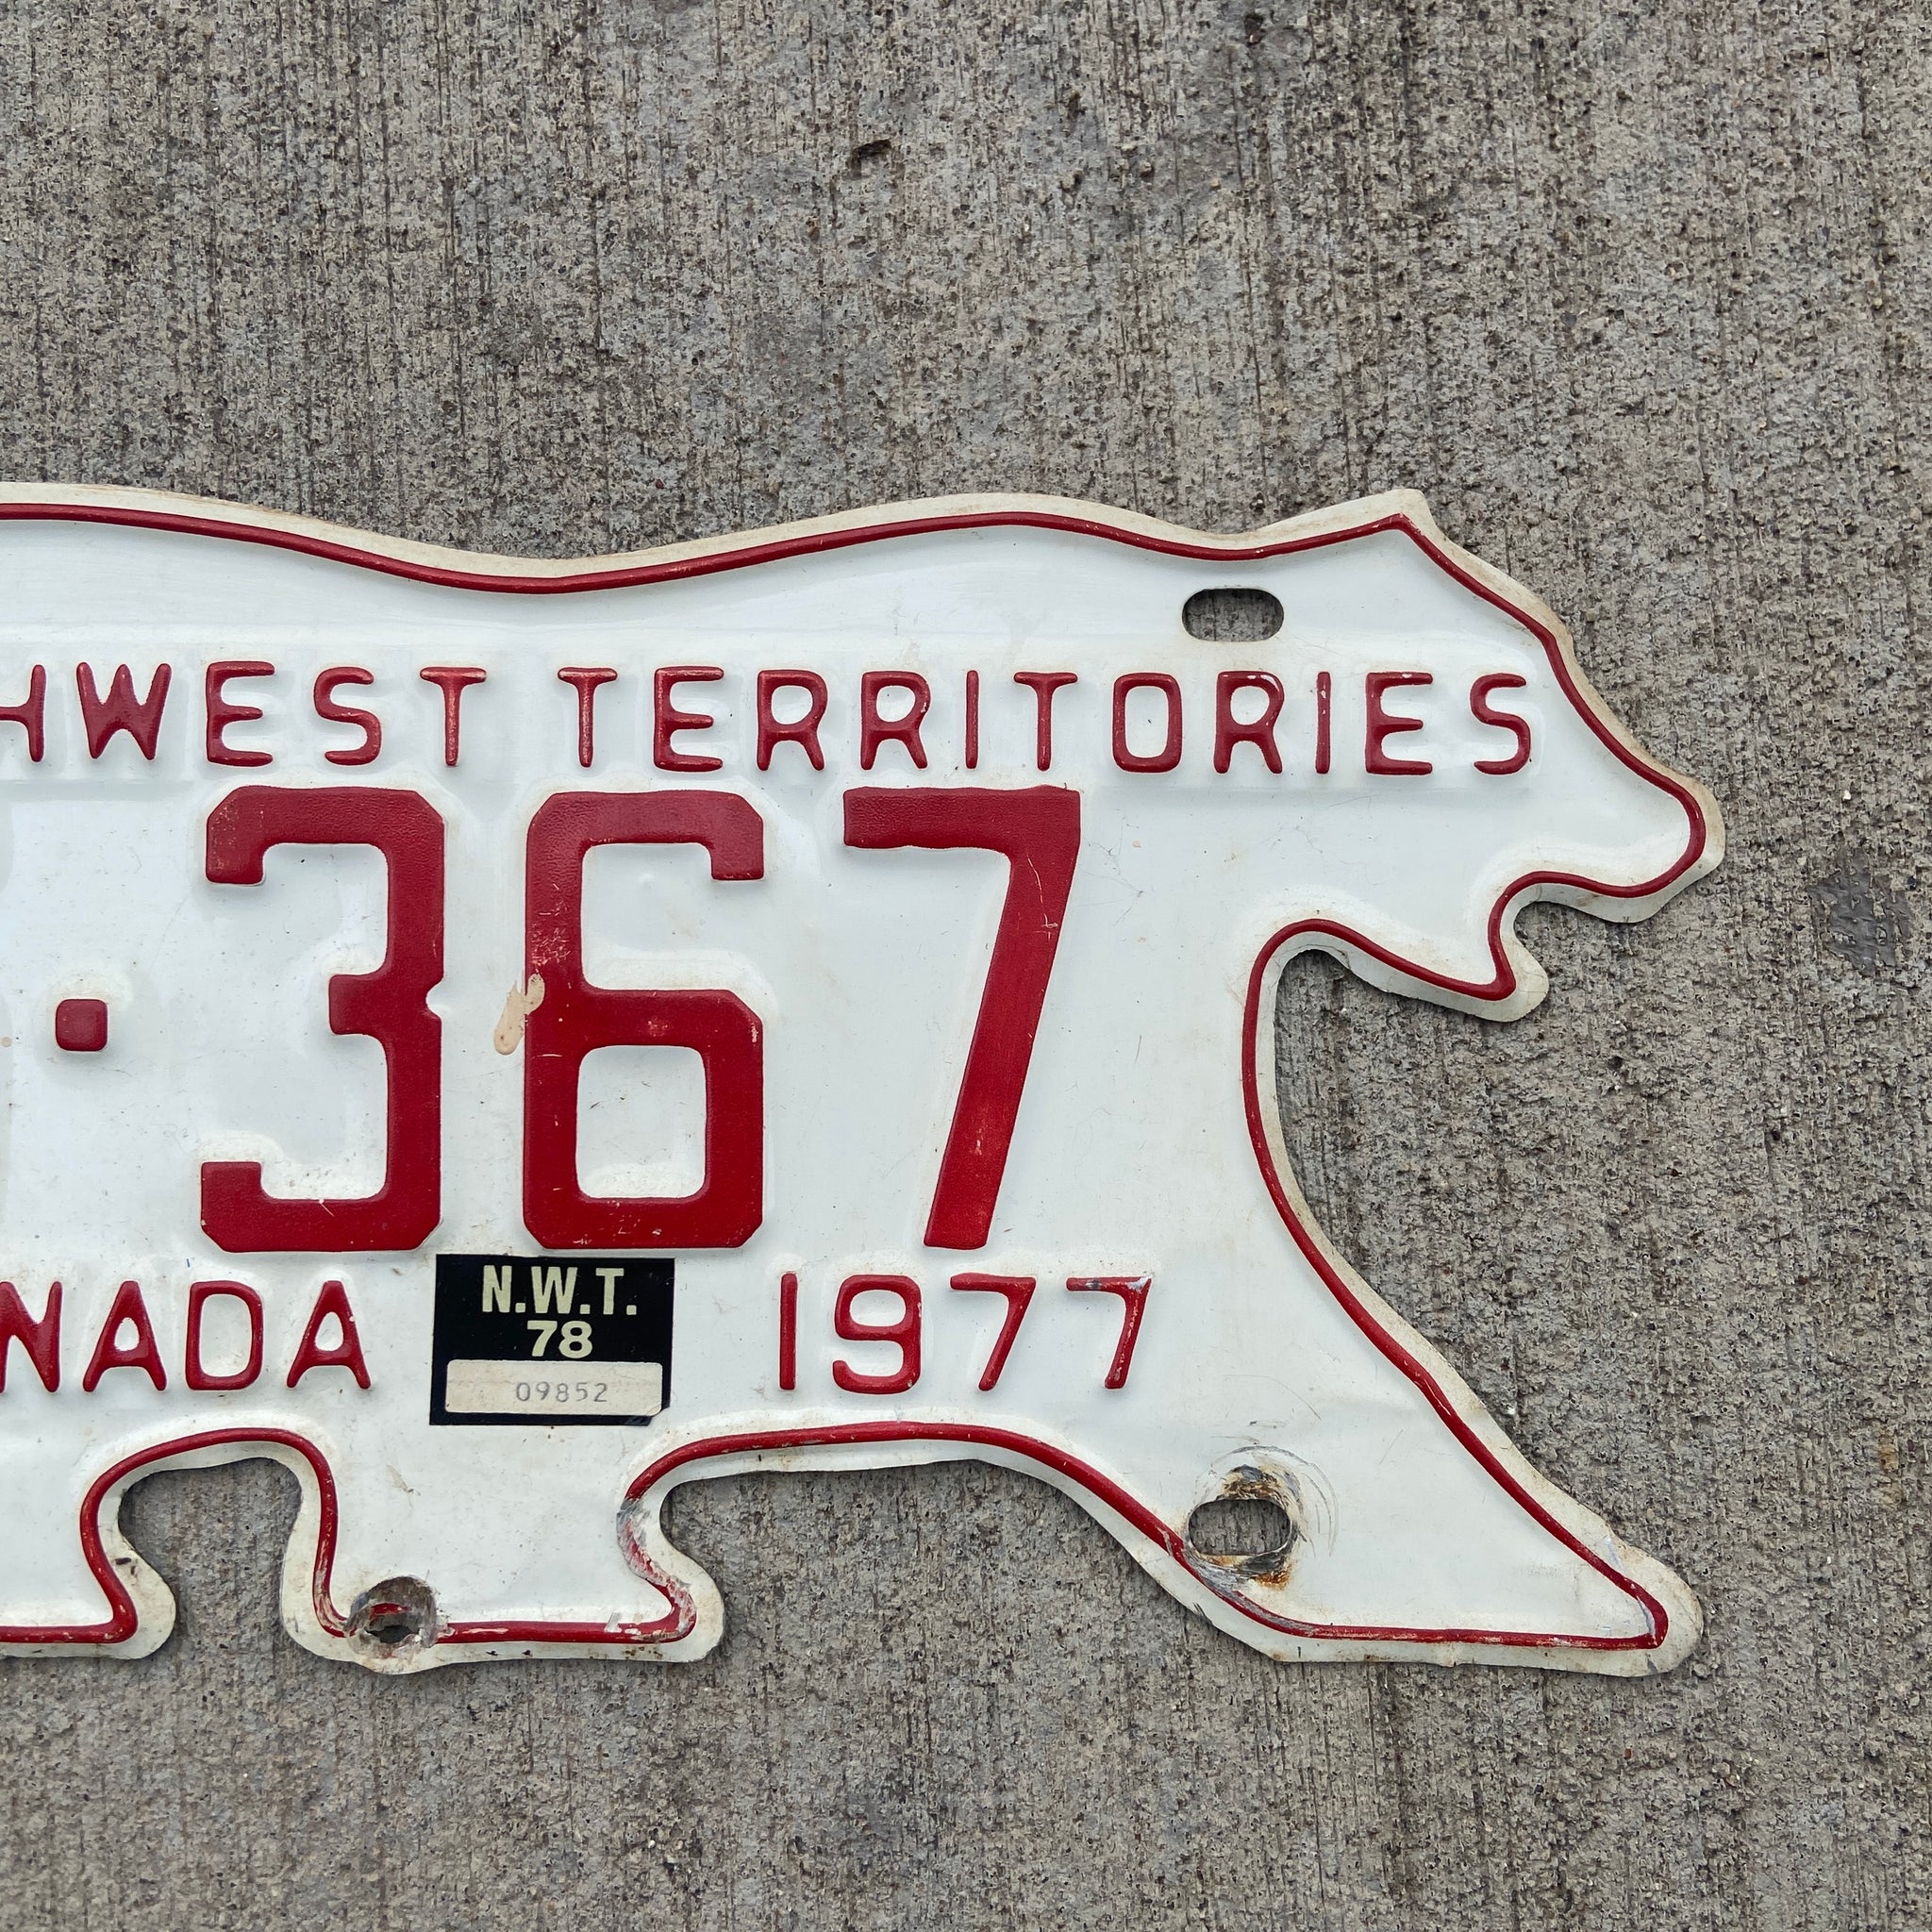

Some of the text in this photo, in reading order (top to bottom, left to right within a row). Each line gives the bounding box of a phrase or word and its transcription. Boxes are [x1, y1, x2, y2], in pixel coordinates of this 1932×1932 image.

[558, 665, 1531, 775] TERRITORIES
[481, 1264, 638, 1316] N.W.T.
[526, 1319, 593, 1359] 78
[778, 1272, 1152, 1395] 1977
[515, 1380, 609, 1404] 09852
